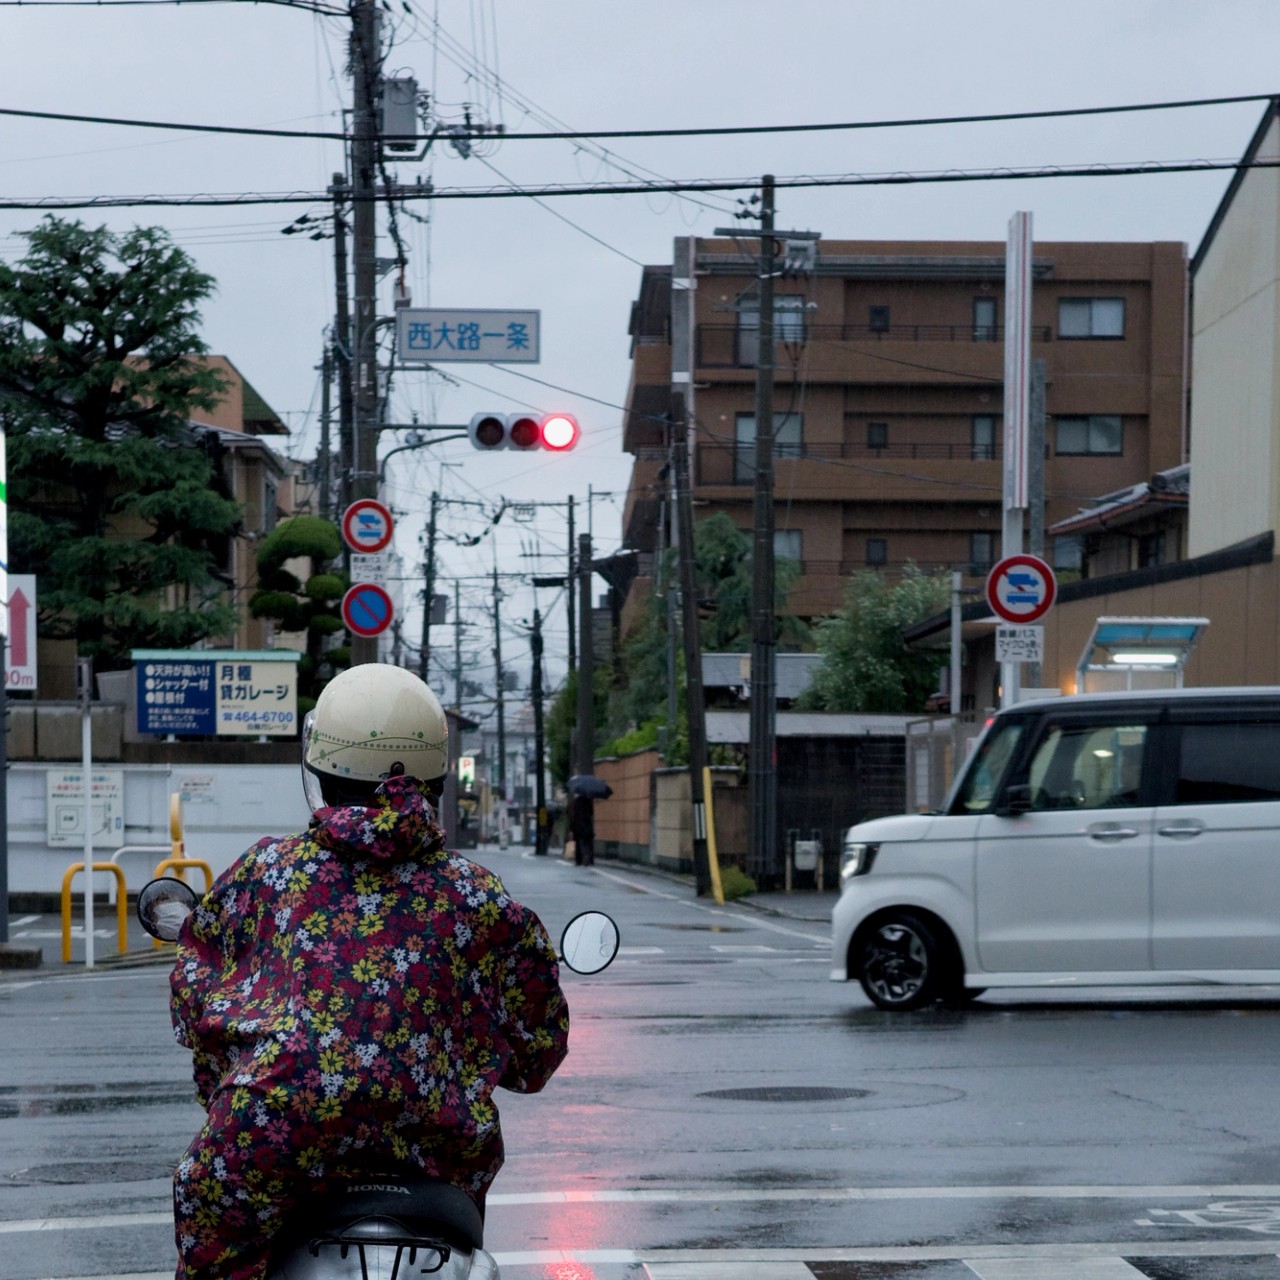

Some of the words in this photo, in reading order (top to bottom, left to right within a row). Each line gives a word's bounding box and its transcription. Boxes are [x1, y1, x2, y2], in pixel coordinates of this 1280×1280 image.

[408, 321, 529, 350] 西大路一条
[221, 665, 251, 682] 月極
[221, 684, 289, 701] 貸ガレージ
[234, 711, 294, 722] 464-6700
[346, 1184, 412, 1195] HONDA
